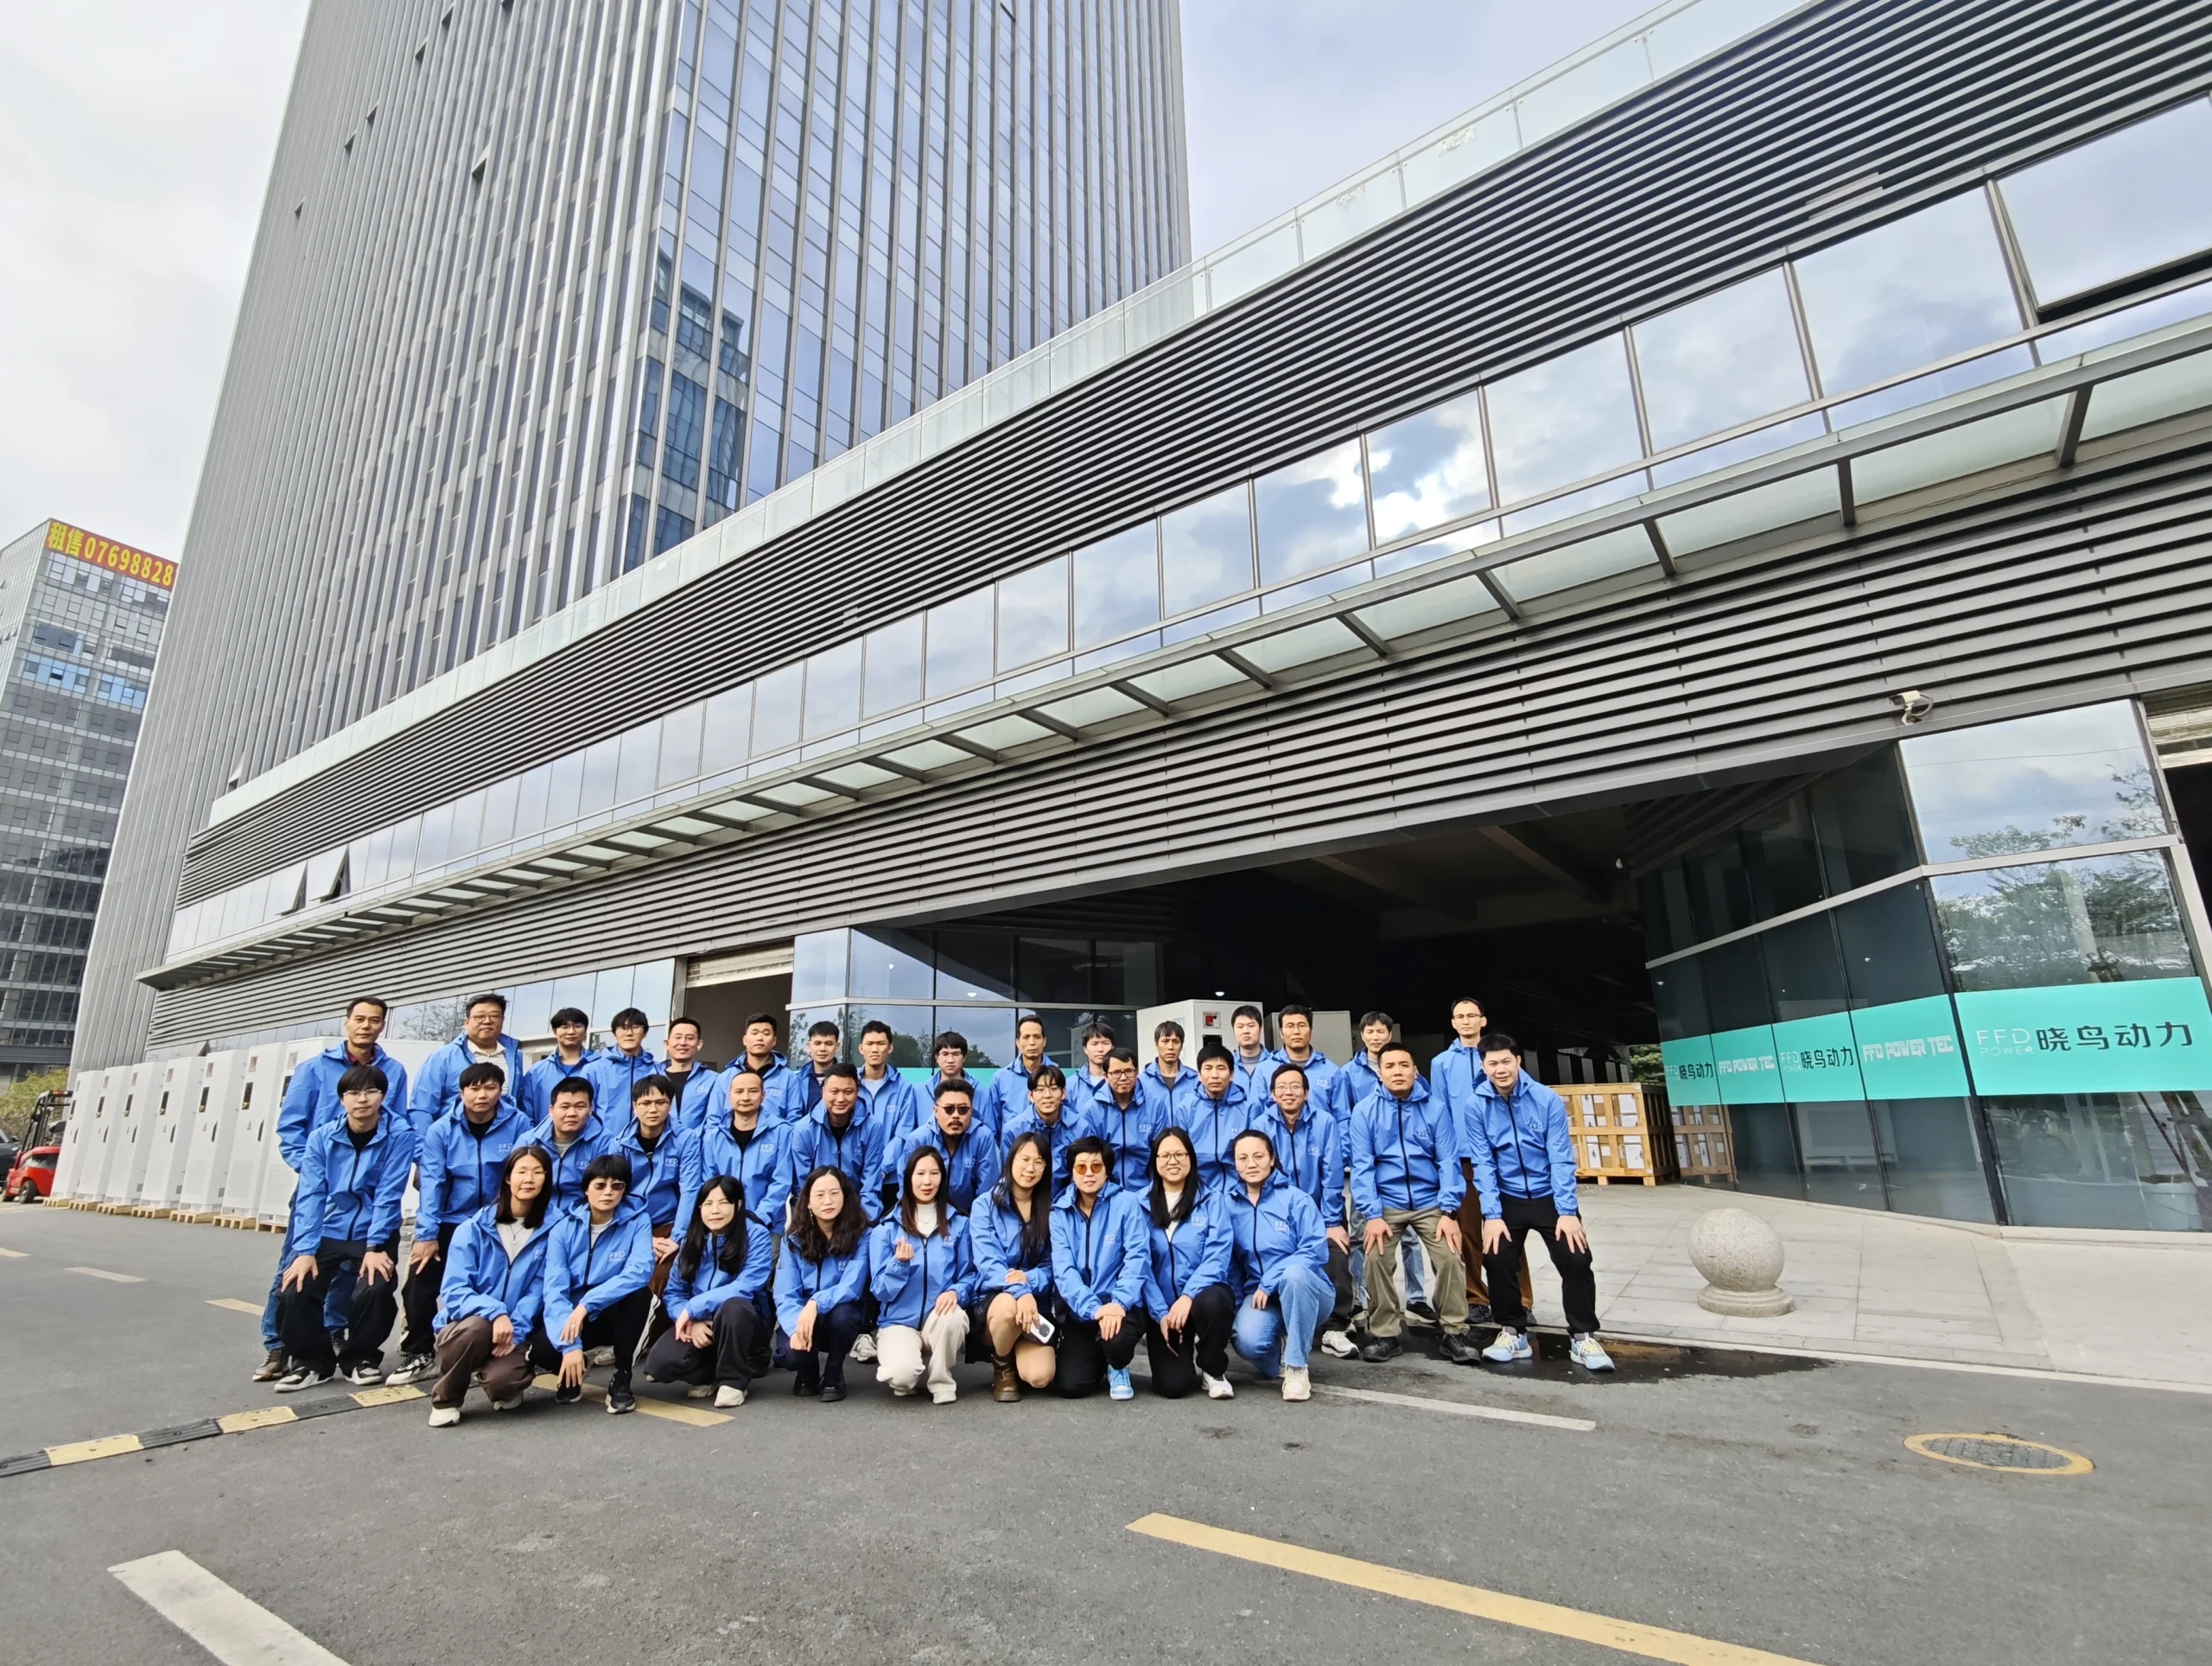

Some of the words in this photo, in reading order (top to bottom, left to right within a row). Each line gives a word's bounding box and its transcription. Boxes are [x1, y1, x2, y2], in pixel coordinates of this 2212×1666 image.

[1976, 1028, 2031, 1046] FFD
[2036, 1021, 2193, 1052] 晓鸟动力
[1800, 1046, 1854, 1070] 晓鸟动力
[1885, 1038, 1927, 1061] POWER
[1679, 1061, 1713, 1080] 晓鸟动力
